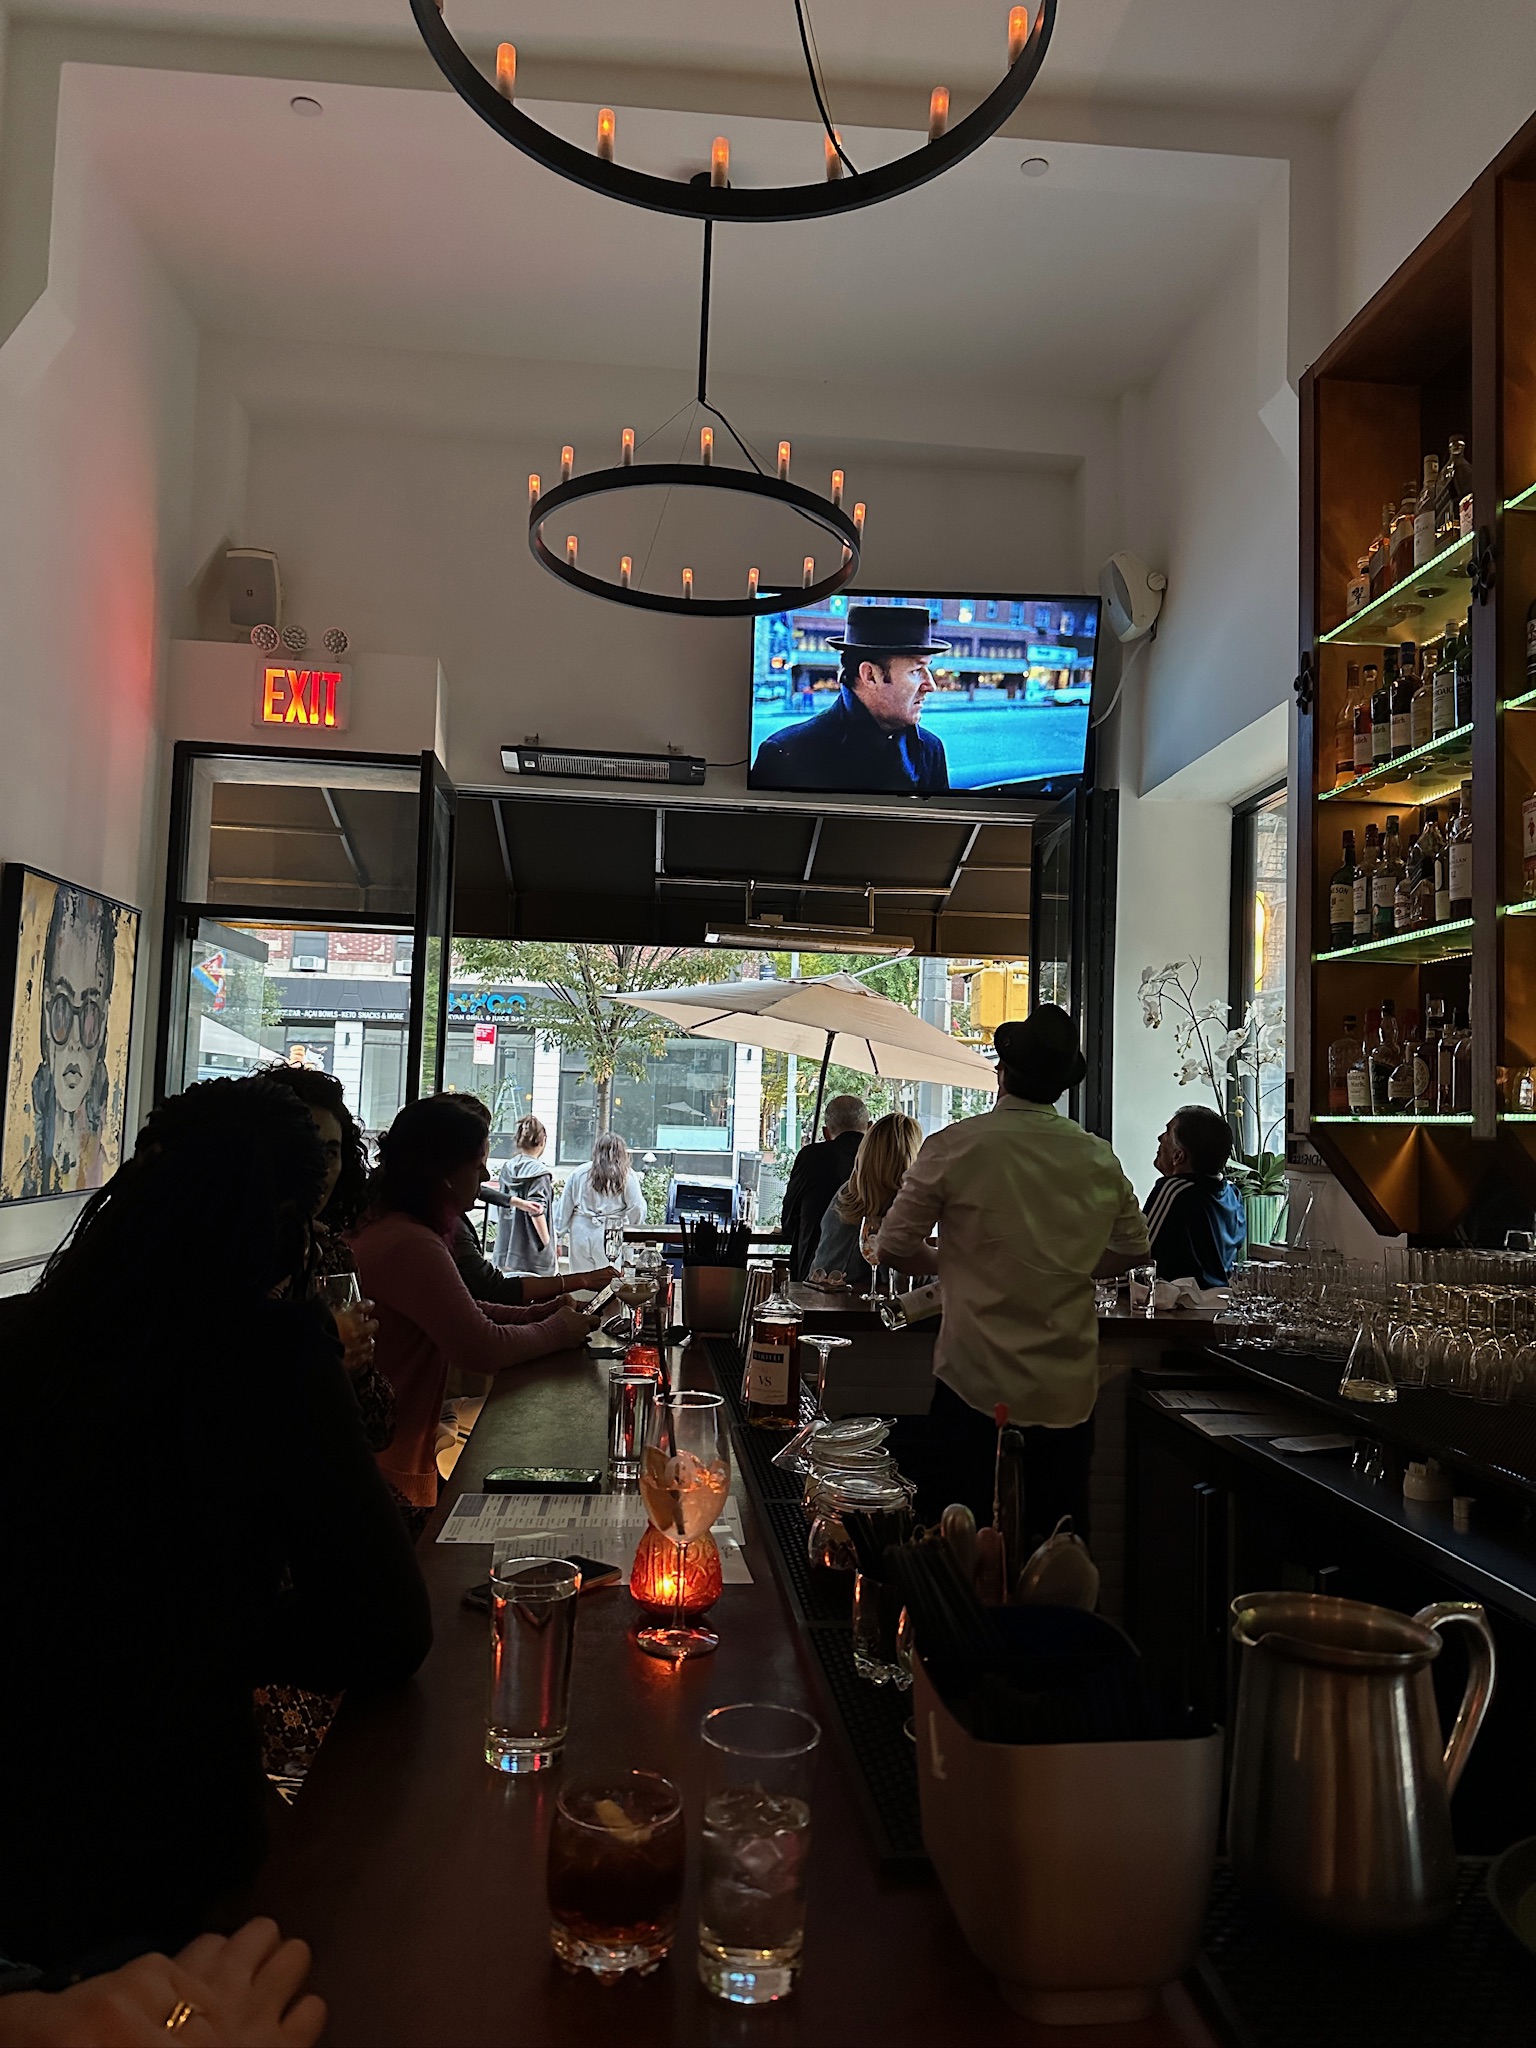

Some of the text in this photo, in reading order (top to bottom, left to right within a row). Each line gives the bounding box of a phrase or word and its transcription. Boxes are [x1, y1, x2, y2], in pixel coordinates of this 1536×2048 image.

[263, 668, 342, 727] EXIT
[341, 1011, 357, 1019] KETO
[357, 1012, 381, 1020] SNACKS
[387, 1013, 405, 1021] MORE
[492, 1015, 510, 1023] JUICE
[758, 1375, 772, 1387] VS
